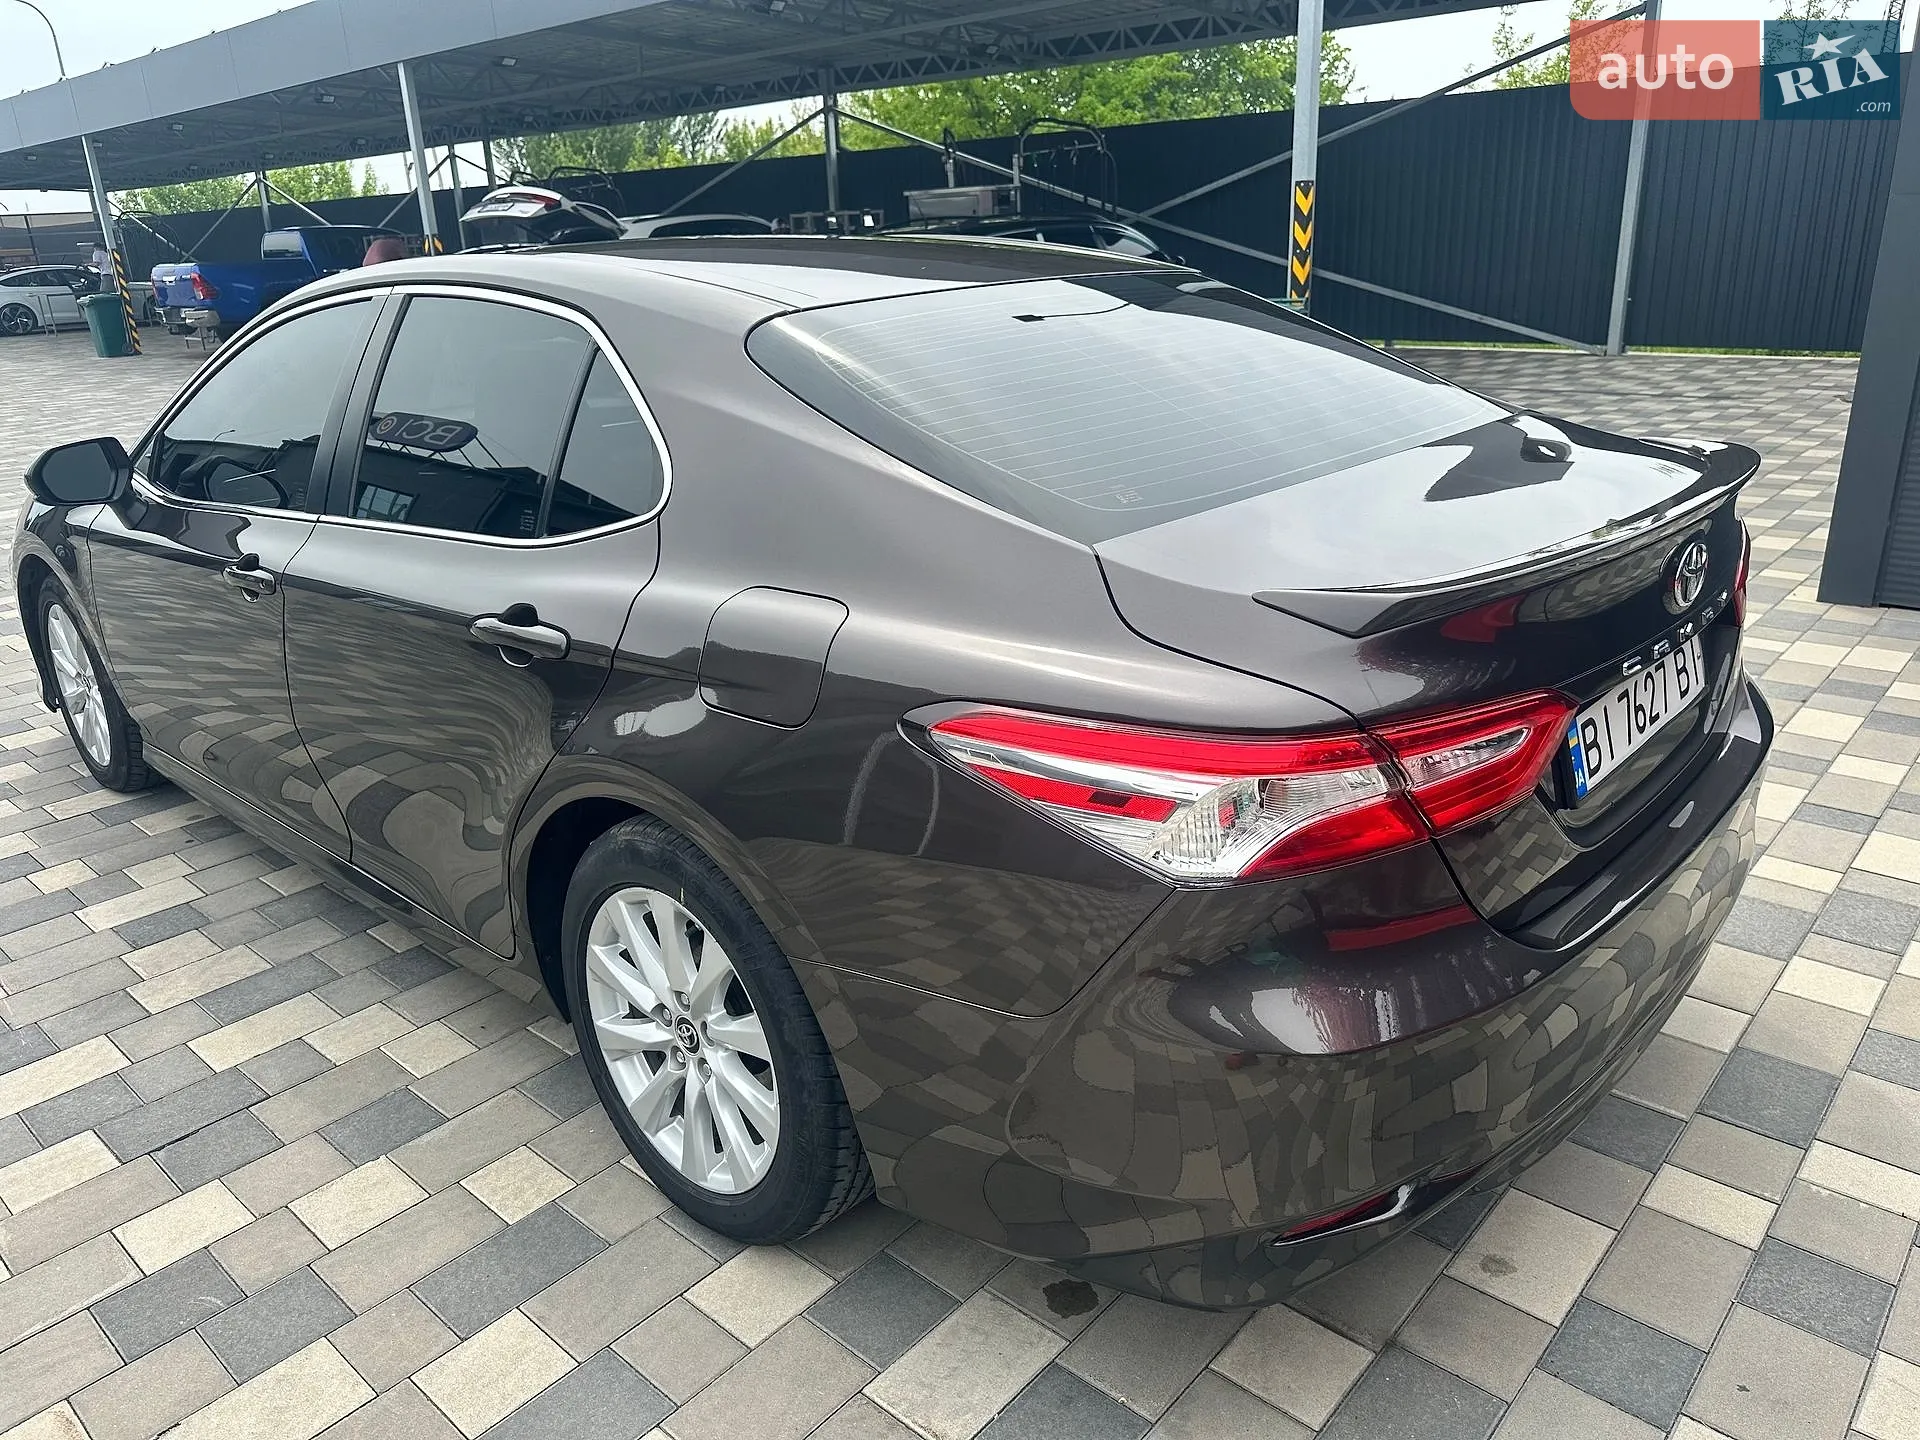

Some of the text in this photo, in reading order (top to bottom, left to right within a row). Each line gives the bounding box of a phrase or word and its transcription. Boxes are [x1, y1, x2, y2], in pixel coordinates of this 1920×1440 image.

[1580, 638, 1699, 780] BI 7627 BI
